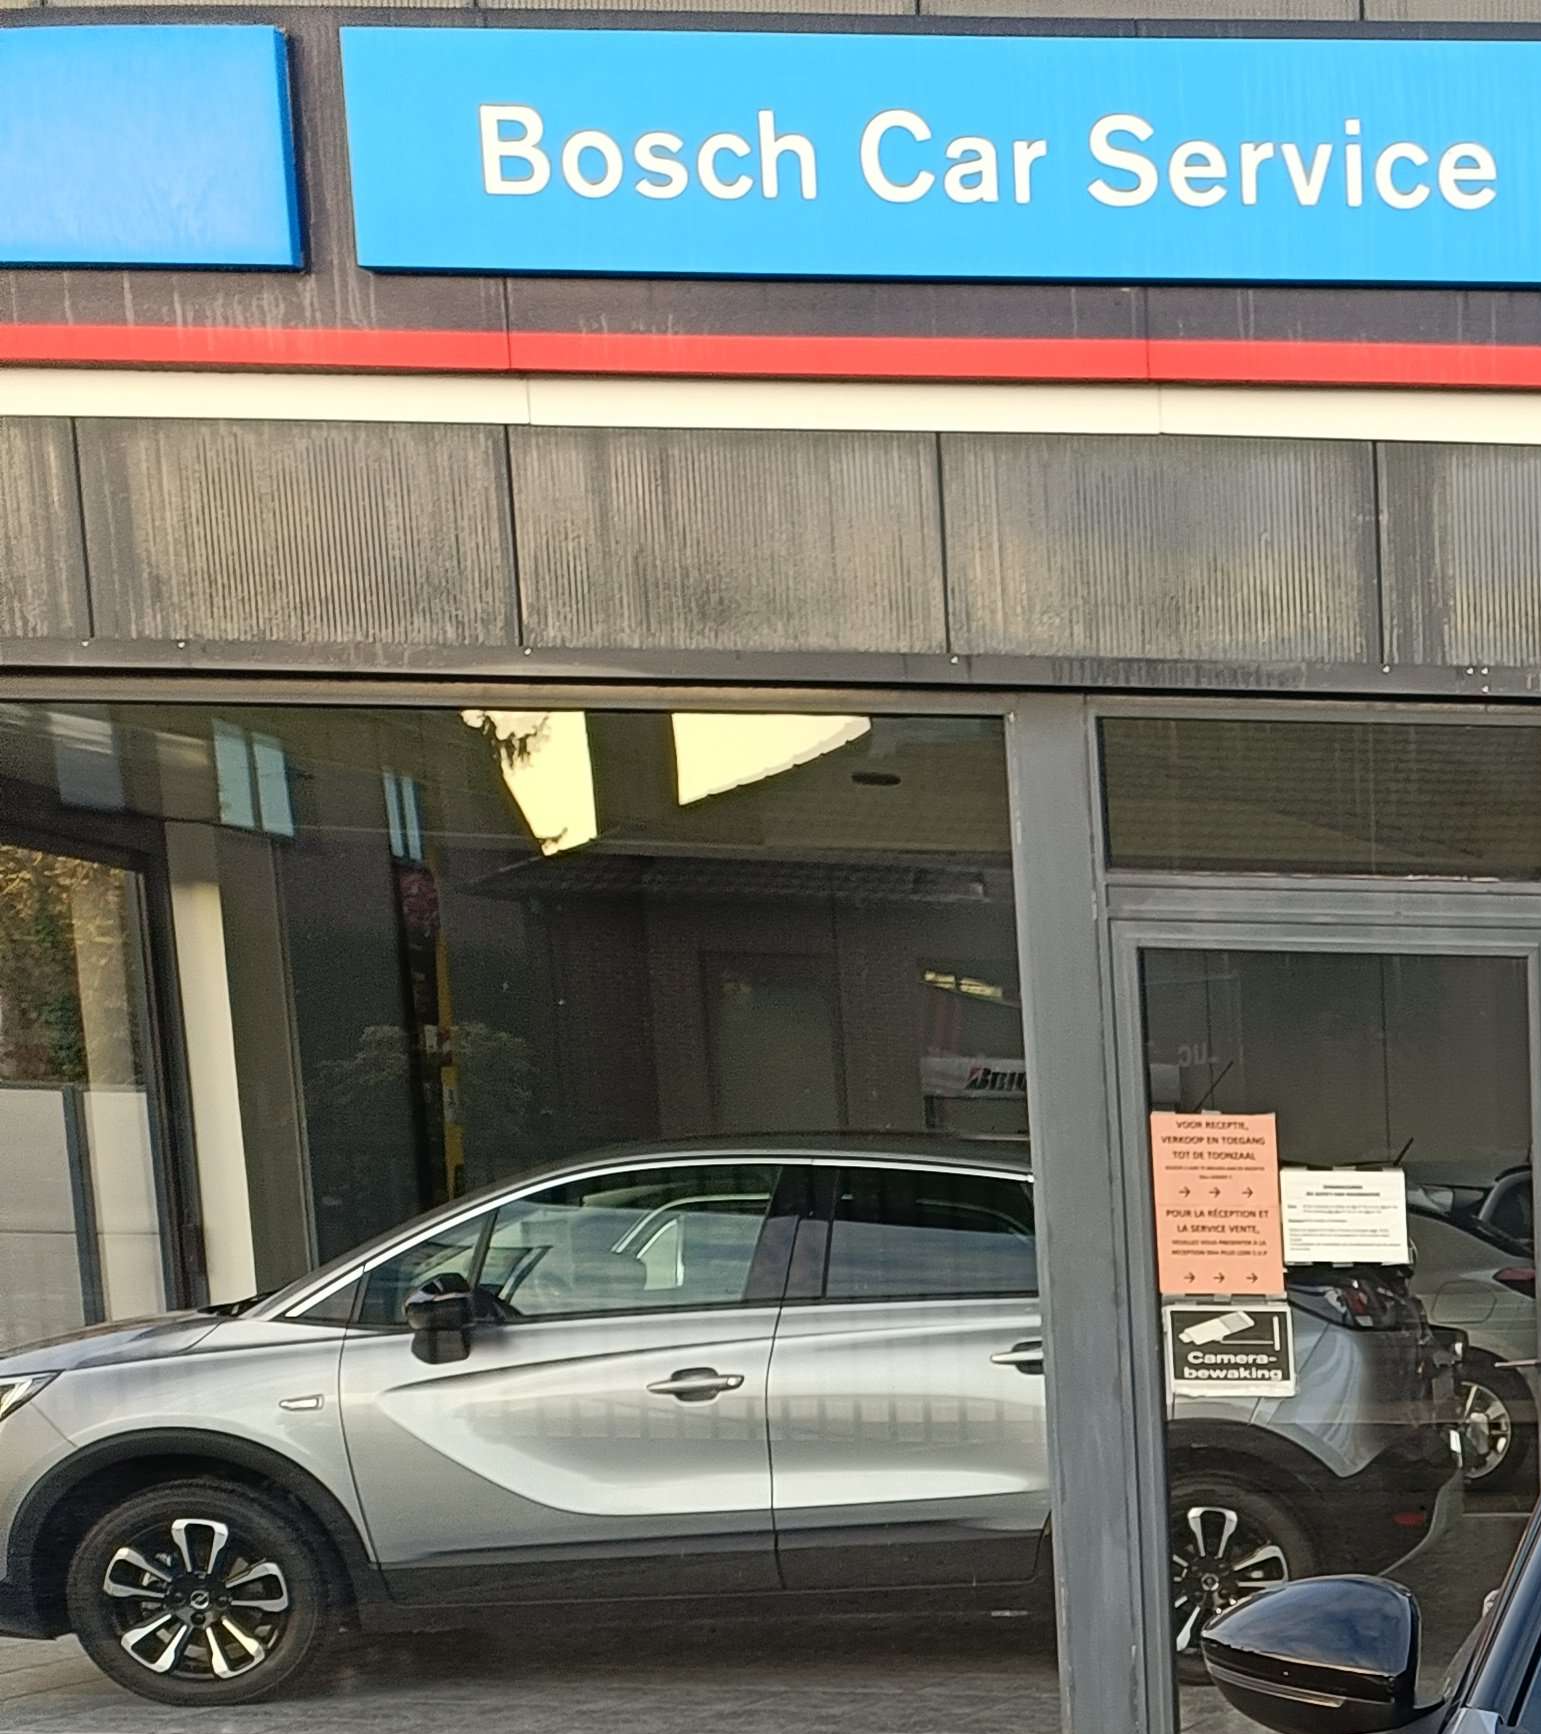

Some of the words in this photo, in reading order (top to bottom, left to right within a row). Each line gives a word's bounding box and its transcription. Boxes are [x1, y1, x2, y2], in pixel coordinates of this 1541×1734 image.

[479, 103, 817, 200] Bosch
[859, 108, 1047, 204] Car
[1087, 112, 1497, 210] Service
[1176, 1121, 1202, 1129] VOOR
[1161, 1136, 1204, 1144] VERKOOP
[1207, 1136, 1219, 1144] EN
[1222, 1136, 1265, 1145] TOEGANG
[1173, 1151, 1190, 1159] TOT
[1193, 1151, 1204, 1159] DE
[1208, 1151, 1256, 1160] TOONZAAL
[1166, 1210, 1191, 1218] POUR
[1194, 1210, 1205, 1218] LA
[1208, 1208, 1256, 1218] RÉCEPTION
[1259, 1210, 1269, 1218] ET
[1177, 1225, 1188, 1233] LA
[1191, 1225, 1225, 1233] SERVICE
[1187, 1351, 1278, 1364] Camera-
[1184, 1366, 1282, 1380] bewaking
